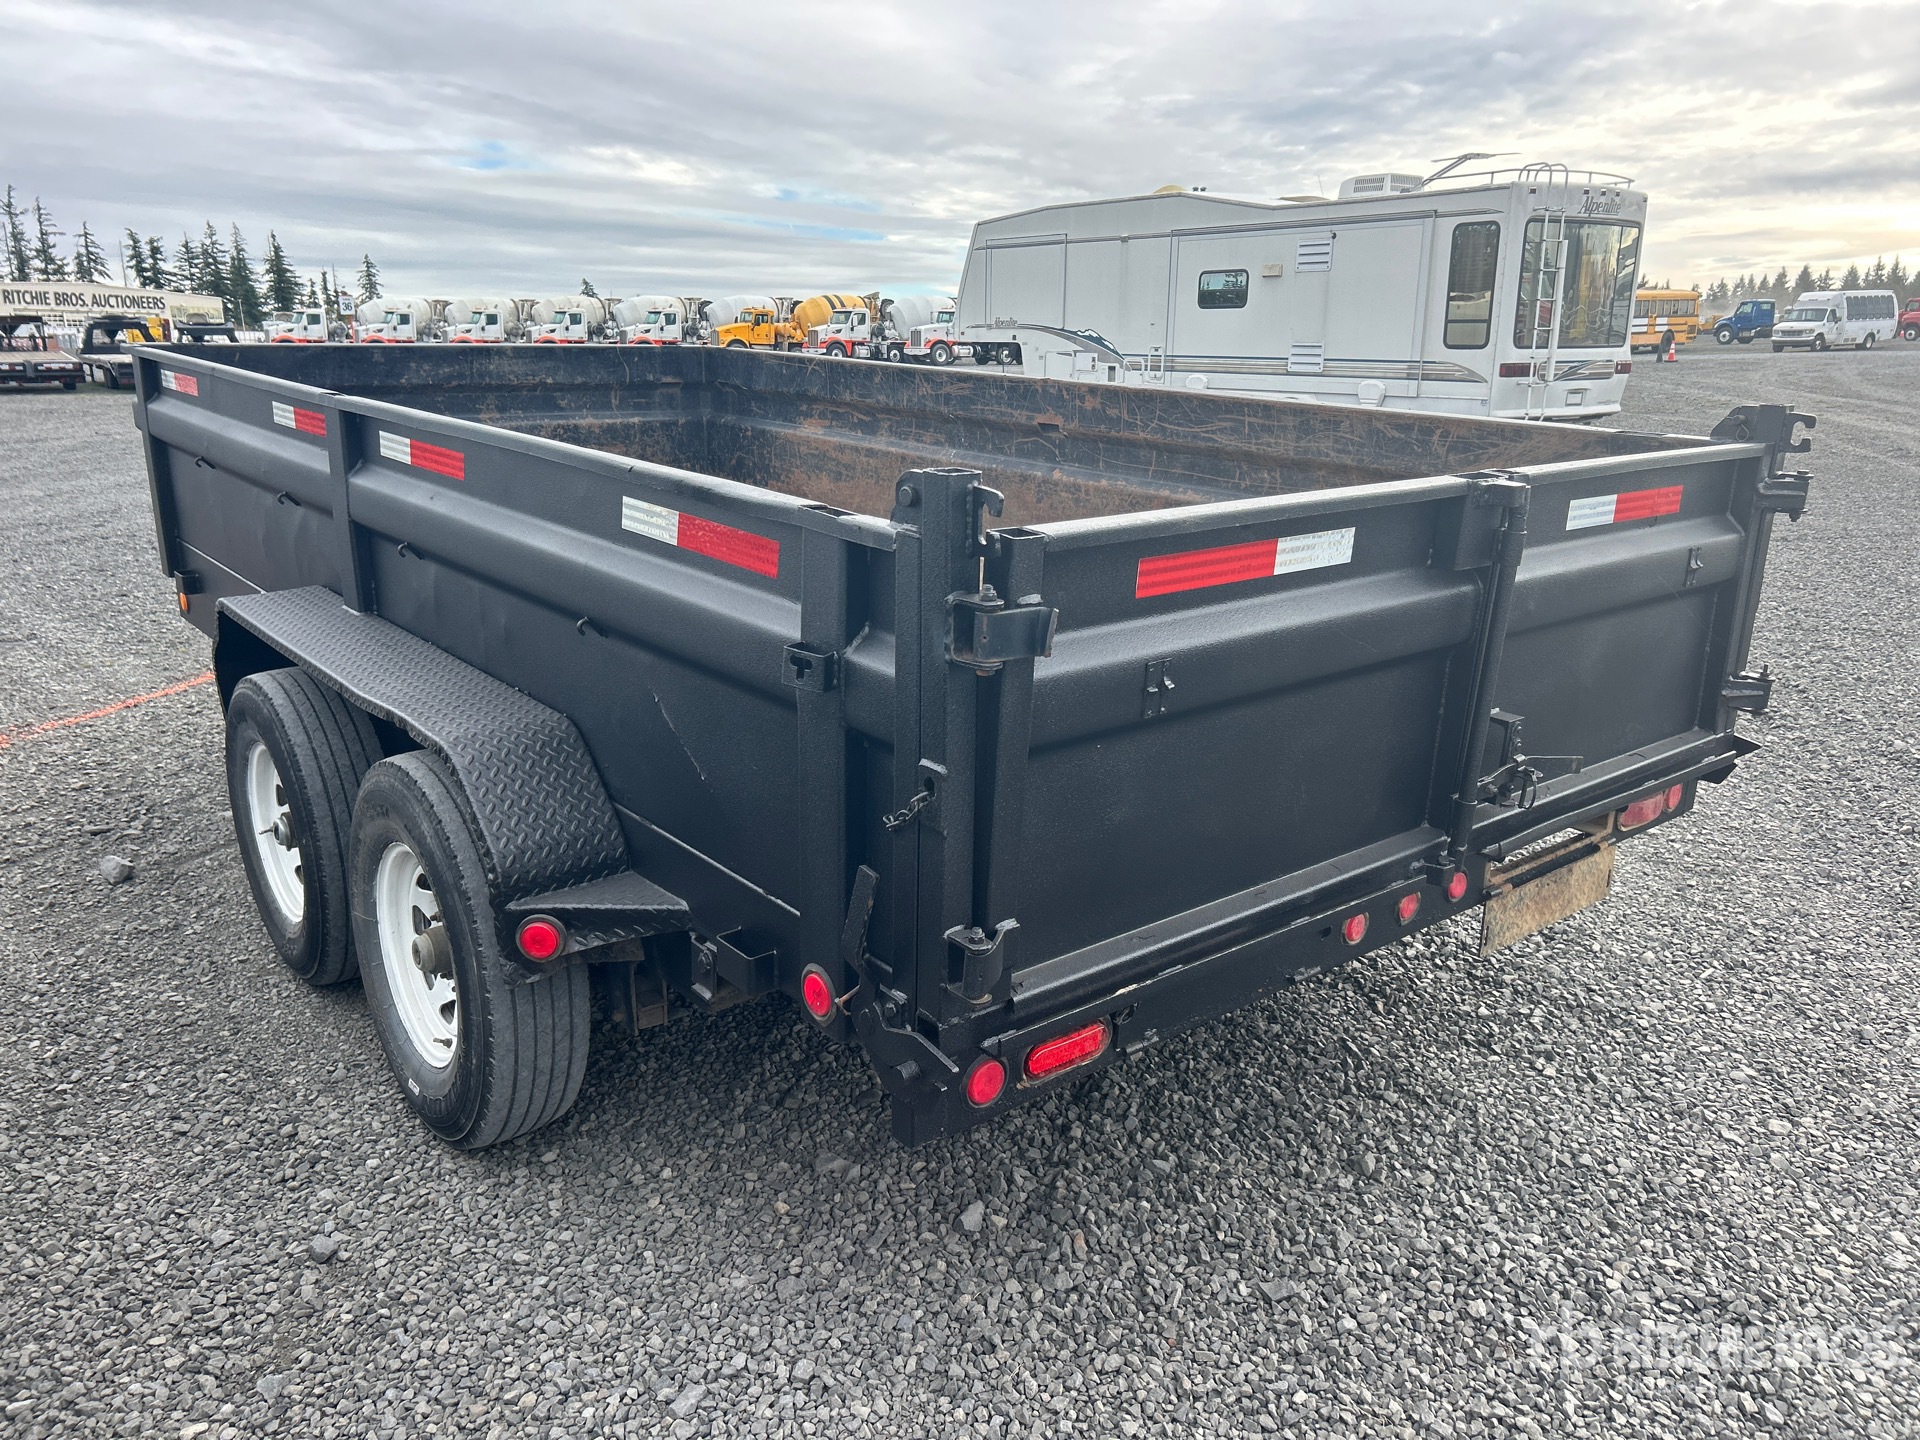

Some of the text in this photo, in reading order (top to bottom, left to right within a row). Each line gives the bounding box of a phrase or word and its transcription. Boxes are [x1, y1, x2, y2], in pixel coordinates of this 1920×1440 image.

[1577, 195, 1622, 217] Alpenlite
[2, 288, 166, 310] RITCHIE BROS. AUCTIONEERS
[341, 302, 353, 312] 36
